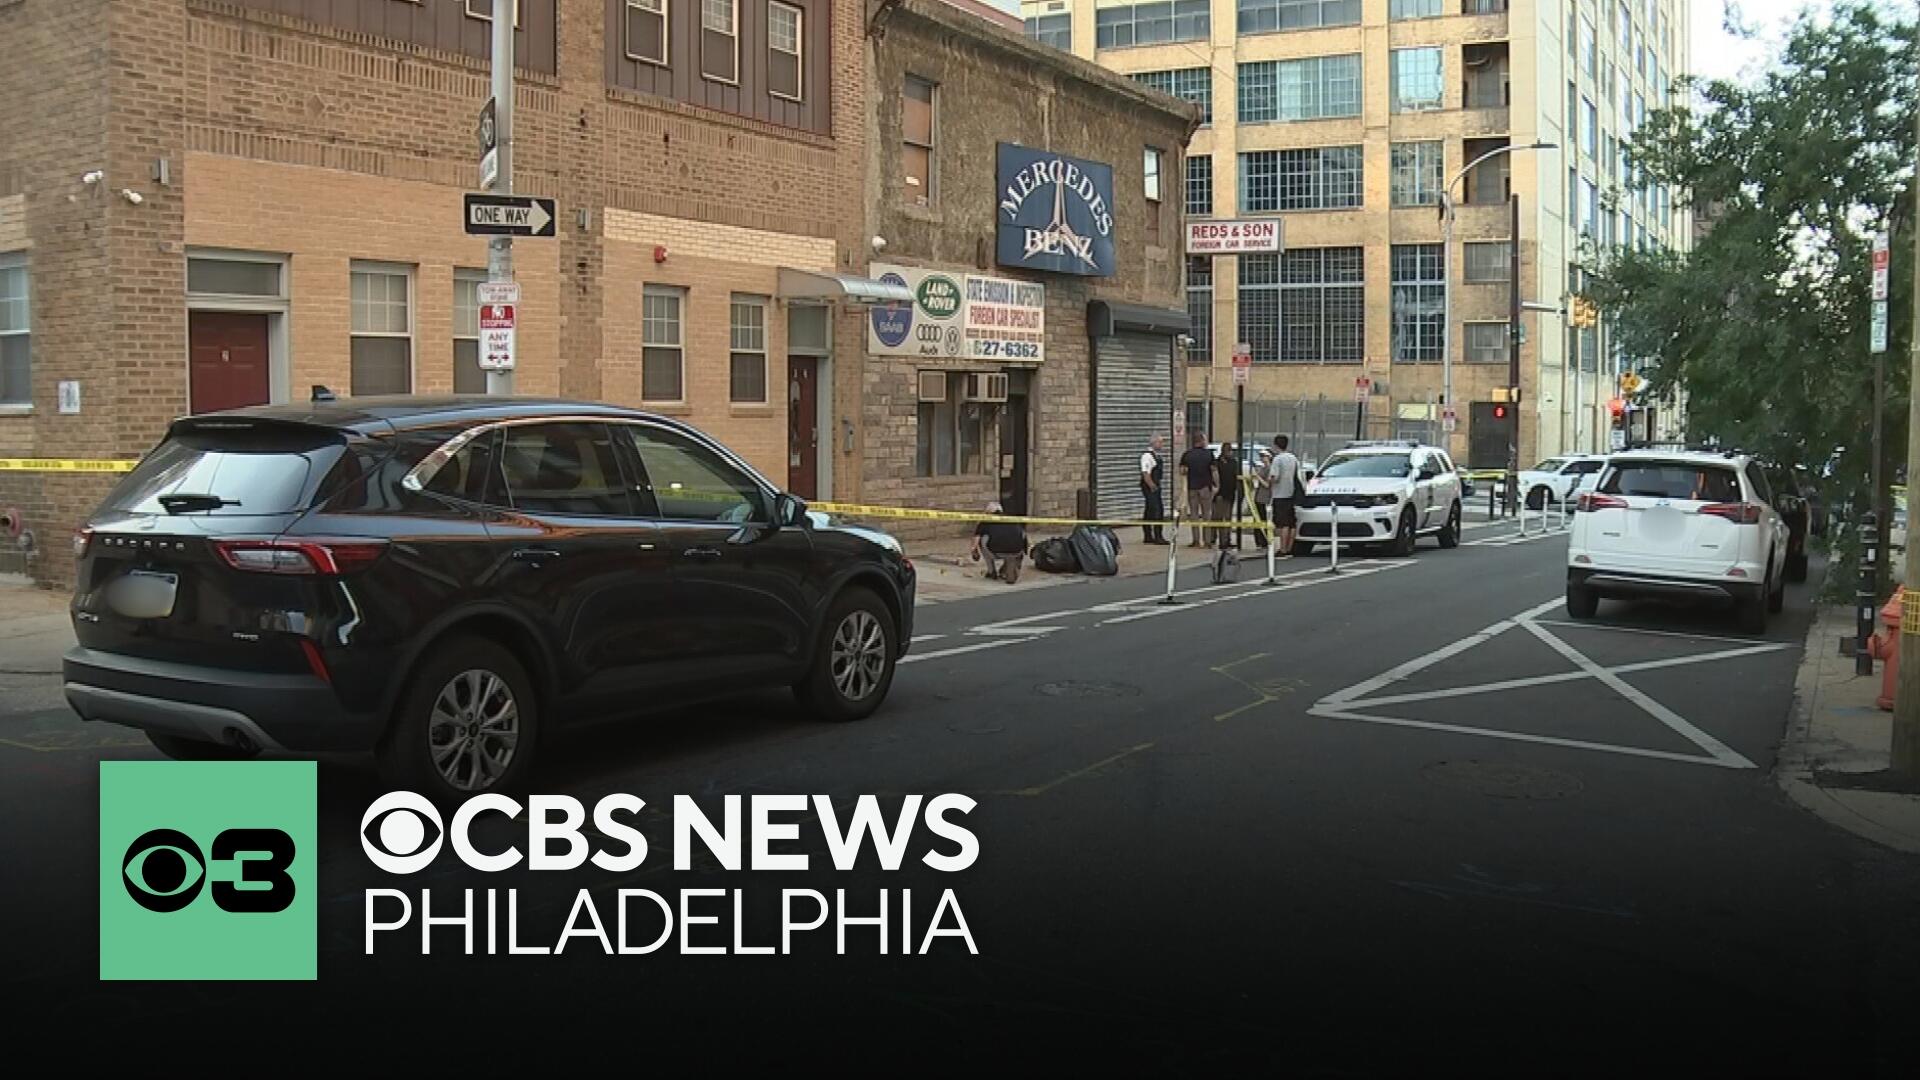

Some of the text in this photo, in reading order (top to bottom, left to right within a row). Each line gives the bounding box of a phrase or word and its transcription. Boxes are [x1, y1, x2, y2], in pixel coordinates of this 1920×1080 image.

[1001, 158, 1113, 236] MERCEDES
[475, 207, 530, 224] ONE WAY
[1191, 223, 1274, 239] REDS & SON
[1024, 228, 1094, 258] BENZ
[1191, 239, 1272, 249] FOREIGN CAR SERVICE
[926, 281, 949, 296] LAND
[927, 296, 956, 311] ROVER
[492, 306, 505, 319] NO
[970, 305, 1040, 329] FOREIGN CAR SPECIALIST
[488, 332, 508, 341] ANY
[488, 342, 508, 351] TIME
